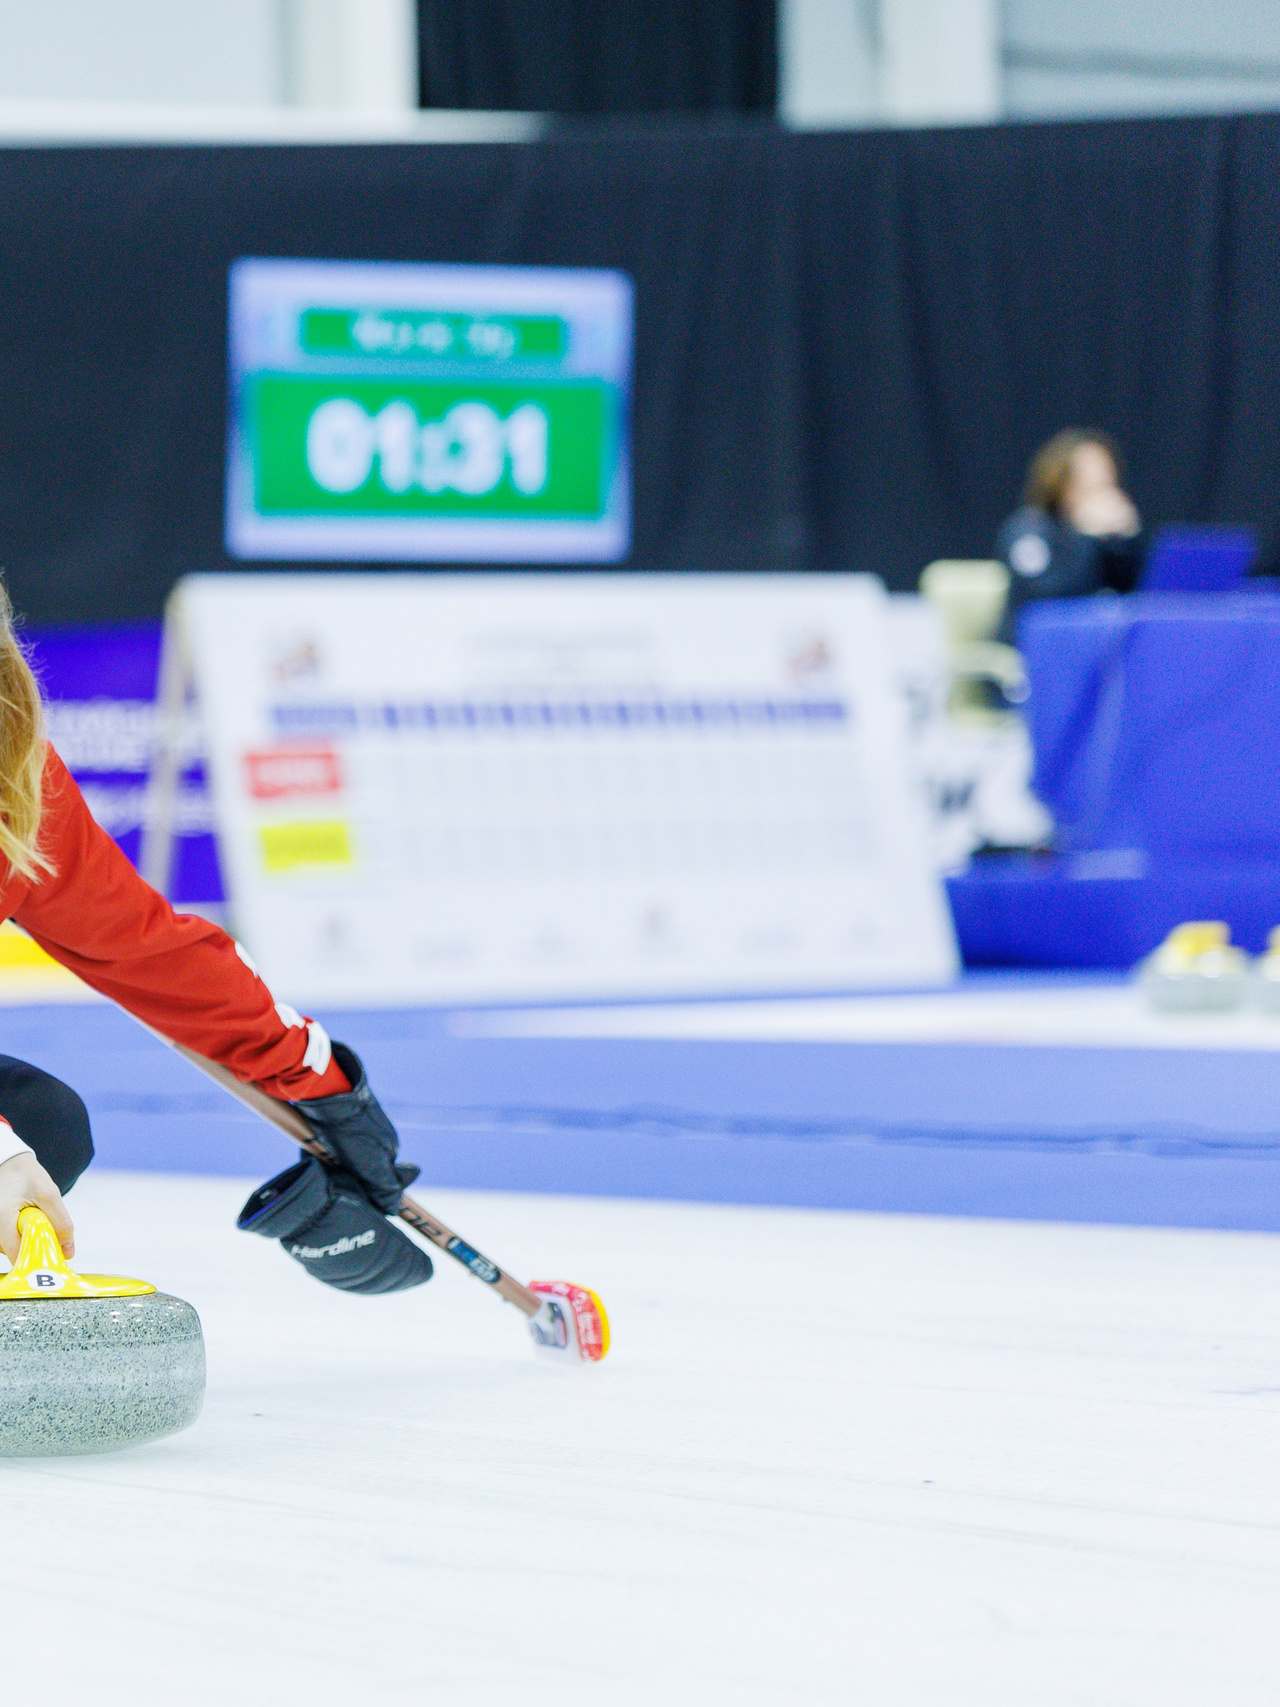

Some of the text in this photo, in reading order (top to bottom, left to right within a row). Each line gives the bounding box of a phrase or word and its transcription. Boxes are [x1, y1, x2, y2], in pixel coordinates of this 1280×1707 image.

[307, 397, 549, 496] 01:31
[291, 1229, 376, 1258] Hardline
[36, 1274, 56, 1287] B
